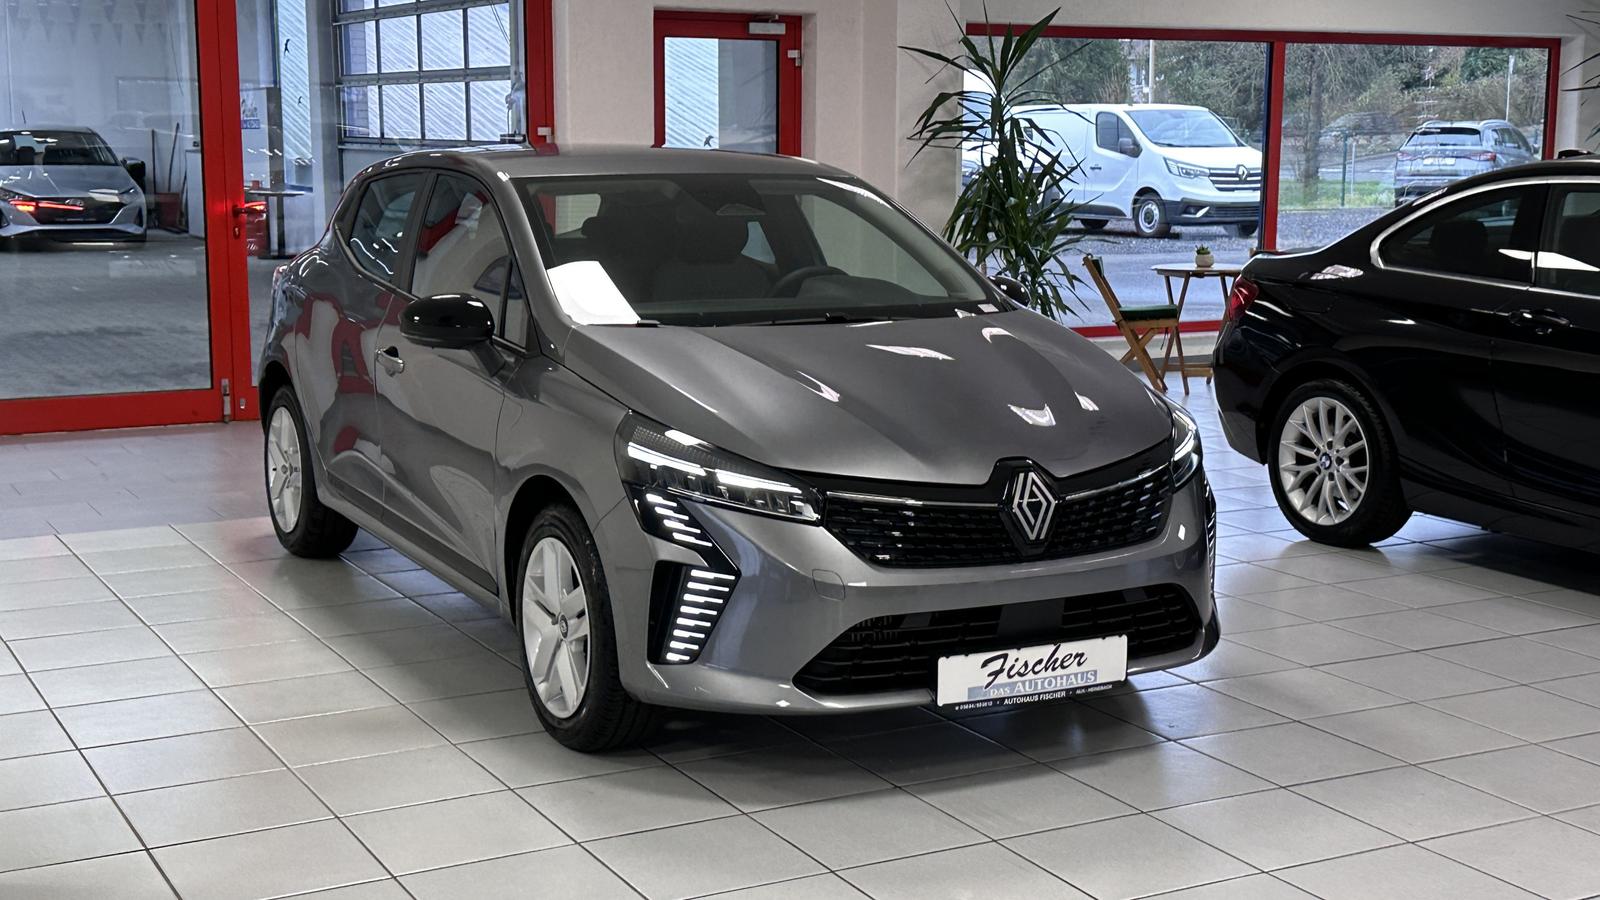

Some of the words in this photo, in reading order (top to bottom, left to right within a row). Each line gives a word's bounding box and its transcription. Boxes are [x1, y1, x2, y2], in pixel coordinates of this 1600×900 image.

[980, 643, 1088, 690] Fischer
[990, 686, 1010, 697] DAS
[1014, 671, 1096, 694] AUTOHAUS
[1003, 694, 1039, 705] AUTOHAUS
[1039, 690, 1066, 701] FISCHER
